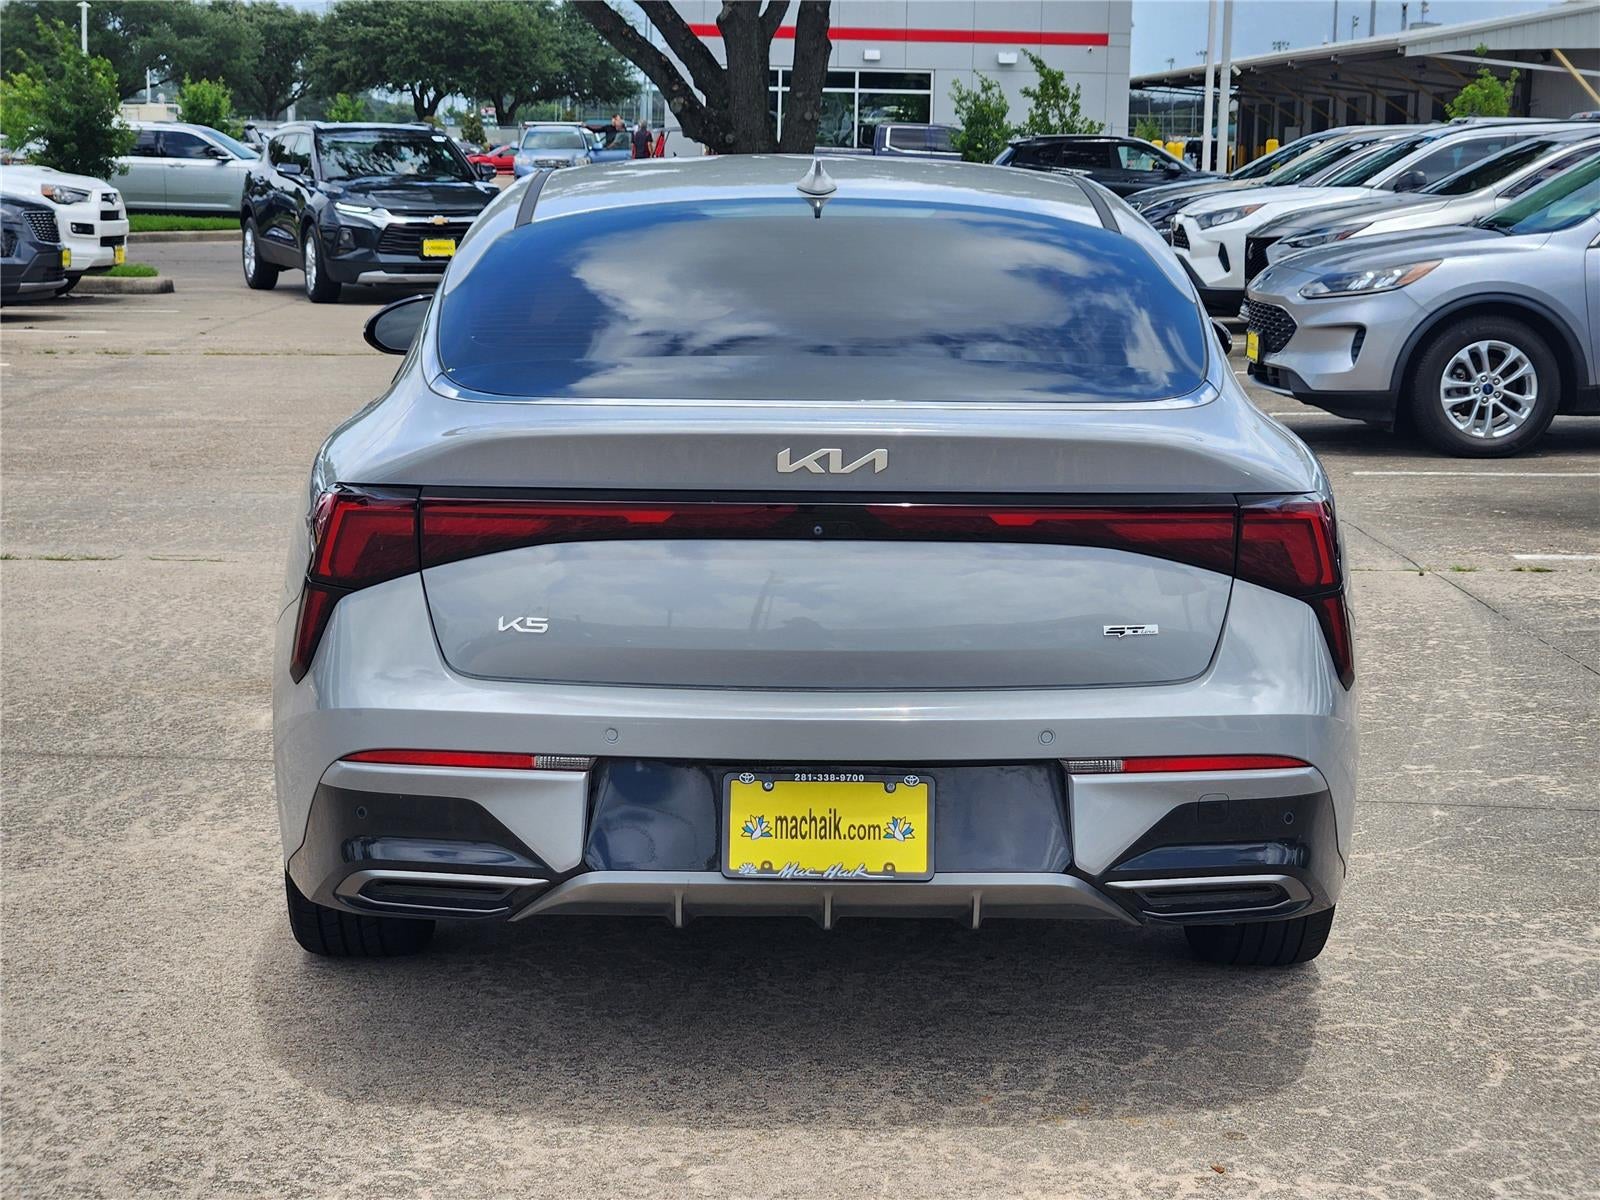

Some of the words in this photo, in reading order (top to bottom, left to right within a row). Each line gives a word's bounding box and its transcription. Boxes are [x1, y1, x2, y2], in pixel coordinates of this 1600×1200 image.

[777, 447, 888, 473] KIA
[498, 616, 549, 633] K5
[794, 773, 865, 782] 281-338-9700
[774, 808, 881, 841] machaik.com
[778, 861, 820, 878] Mac
